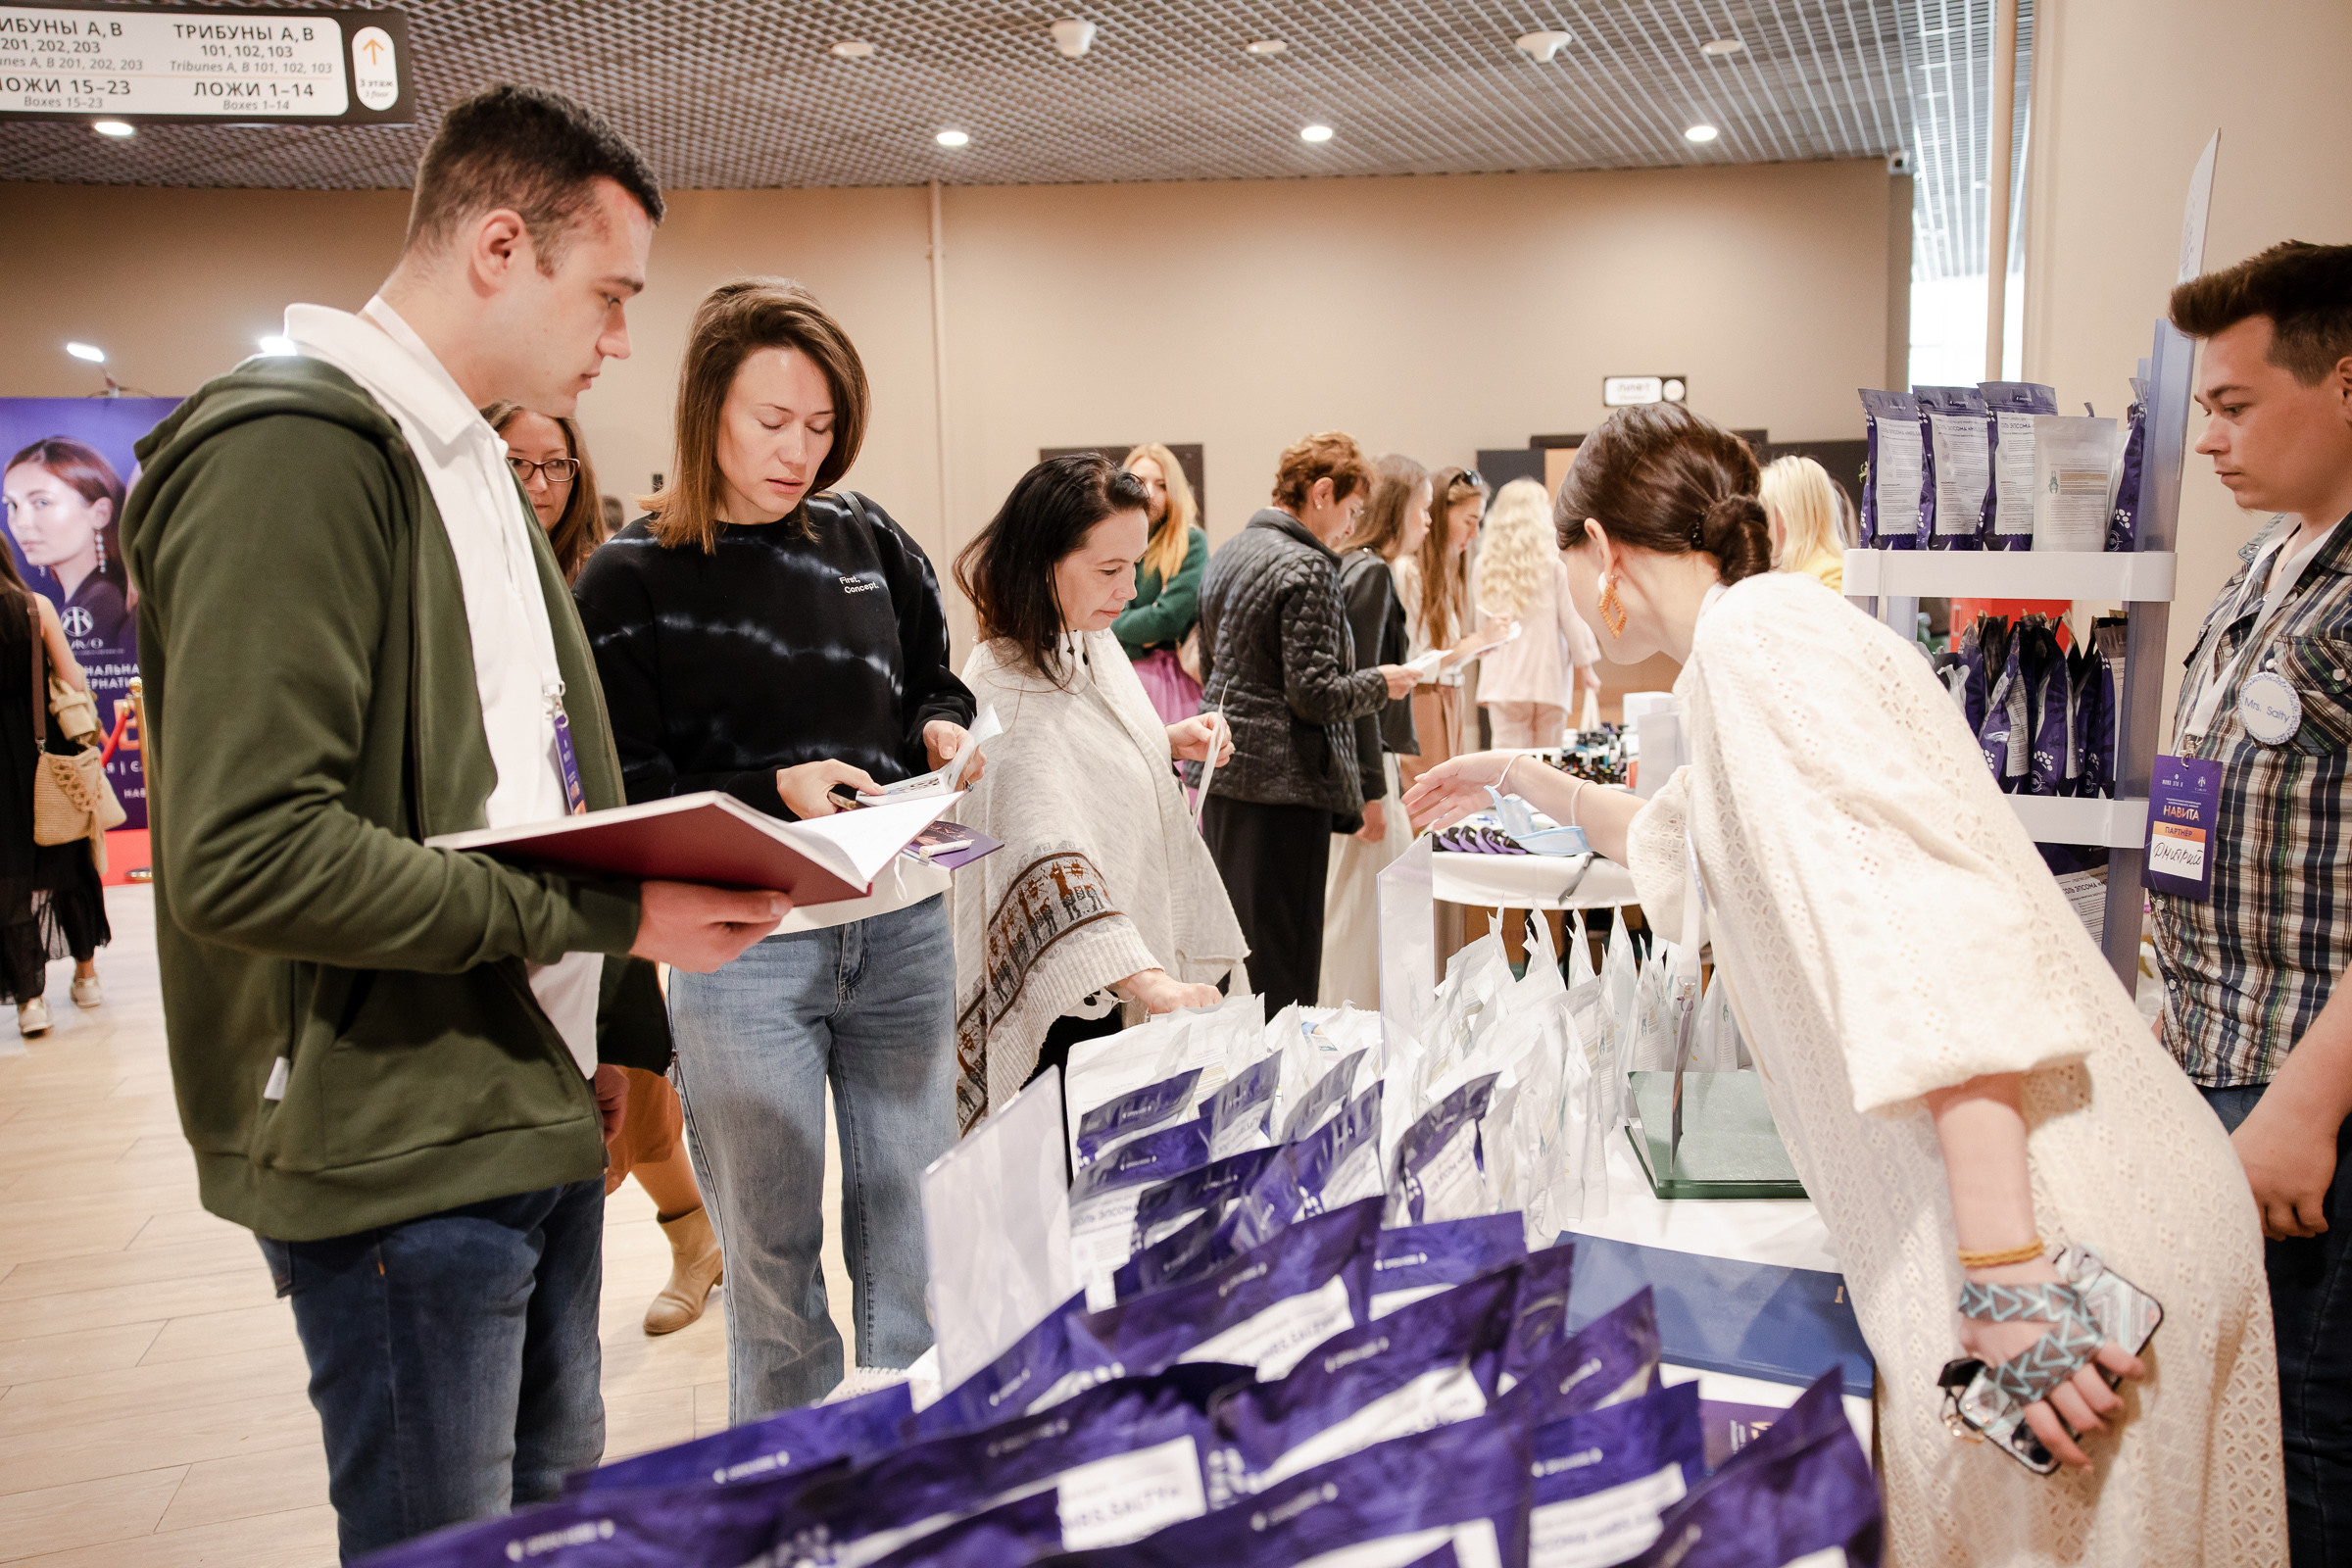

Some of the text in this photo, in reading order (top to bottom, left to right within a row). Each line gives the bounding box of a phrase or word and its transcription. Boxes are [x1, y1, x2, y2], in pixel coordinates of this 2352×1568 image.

[172, 24, 272, 41] ТРИБУНЫ
[46, 58, 55, 69] B
[120, 59, 143, 71] 203
[170, 60, 222, 72] Tribunes
[241, 61, 250, 72] B
[311, 63, 332, 74] 103
[193, 81, 261, 97] ЛОЖИ
[24, 96, 62, 108] Boxes
[222, 99, 258, 111] Boxes
[845, 582, 879, 594] Concept.
[2266, 705, 2291, 724] Salty
[2162, 805, 2201, 822] НАВИТА
